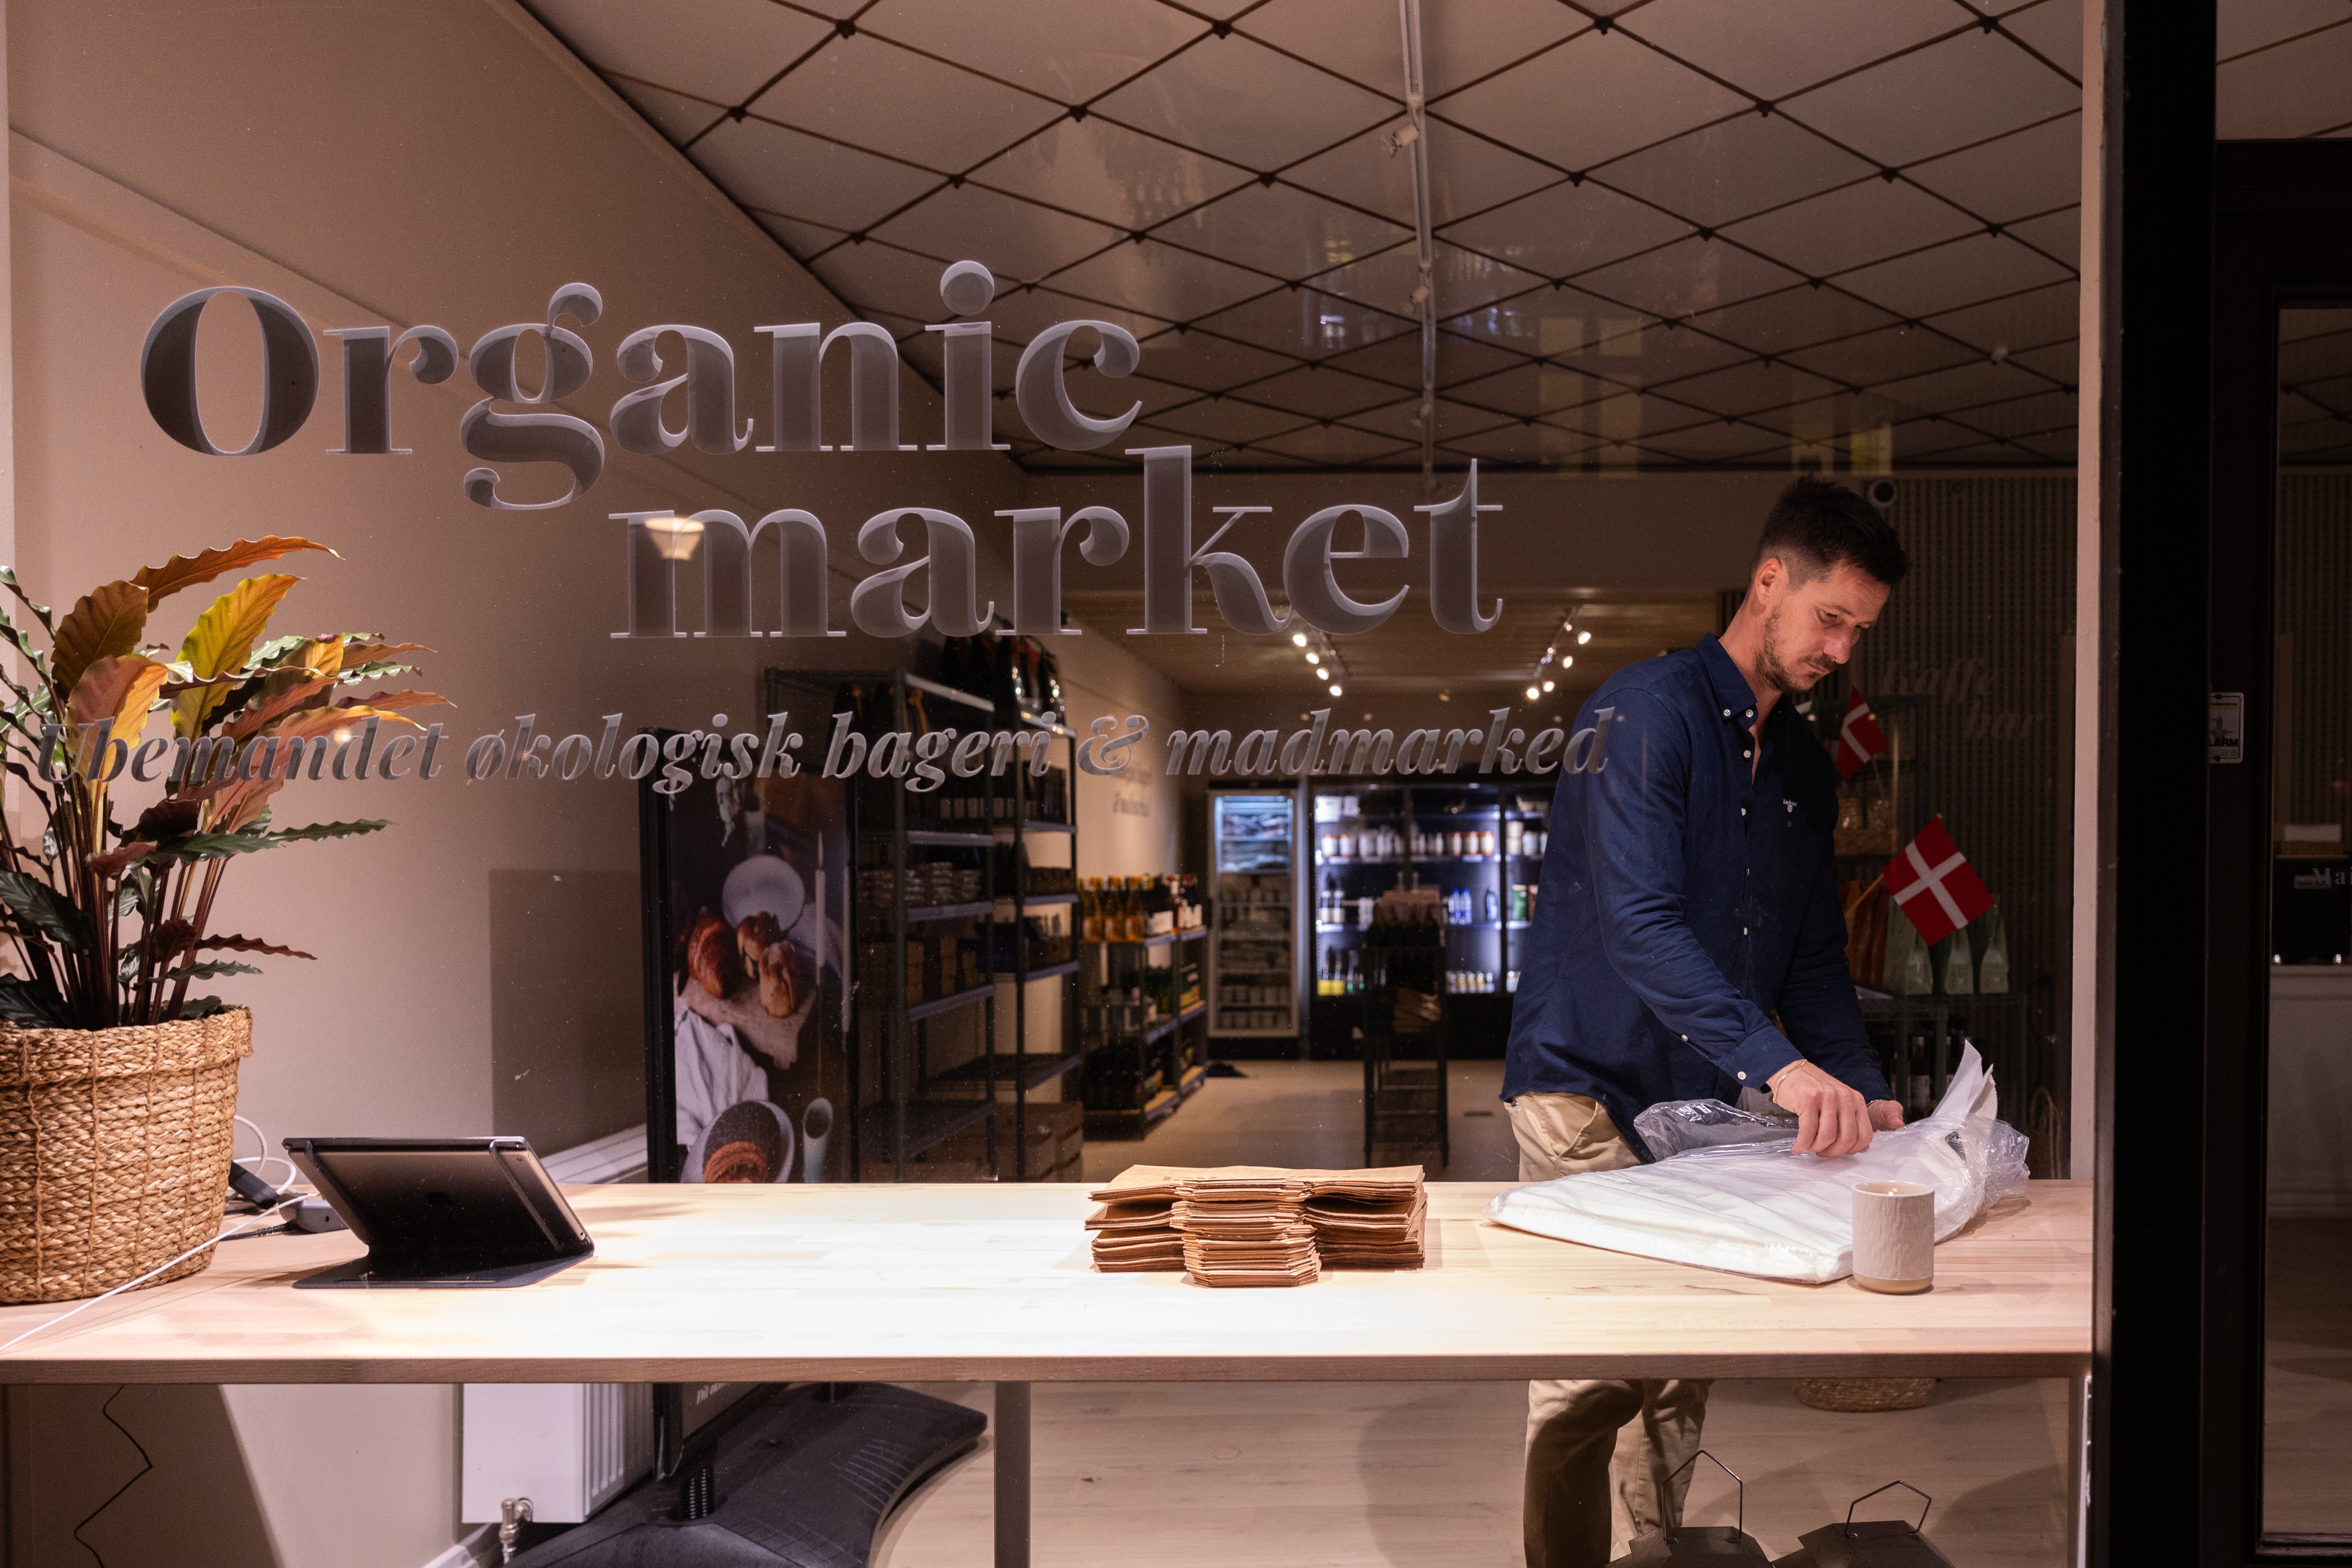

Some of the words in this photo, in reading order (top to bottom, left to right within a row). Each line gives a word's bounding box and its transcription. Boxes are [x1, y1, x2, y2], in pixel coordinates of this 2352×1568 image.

[141, 261, 1141, 510] Organic
[609, 445, 1503, 637] market
[38, 716, 449, 782] Ubemandet
[465, 712, 802, 794] økologisk
[822, 711, 1056, 792] bageri
[1076, 715, 1149, 776] &
[1166, 707, 1615, 776] madmarked
